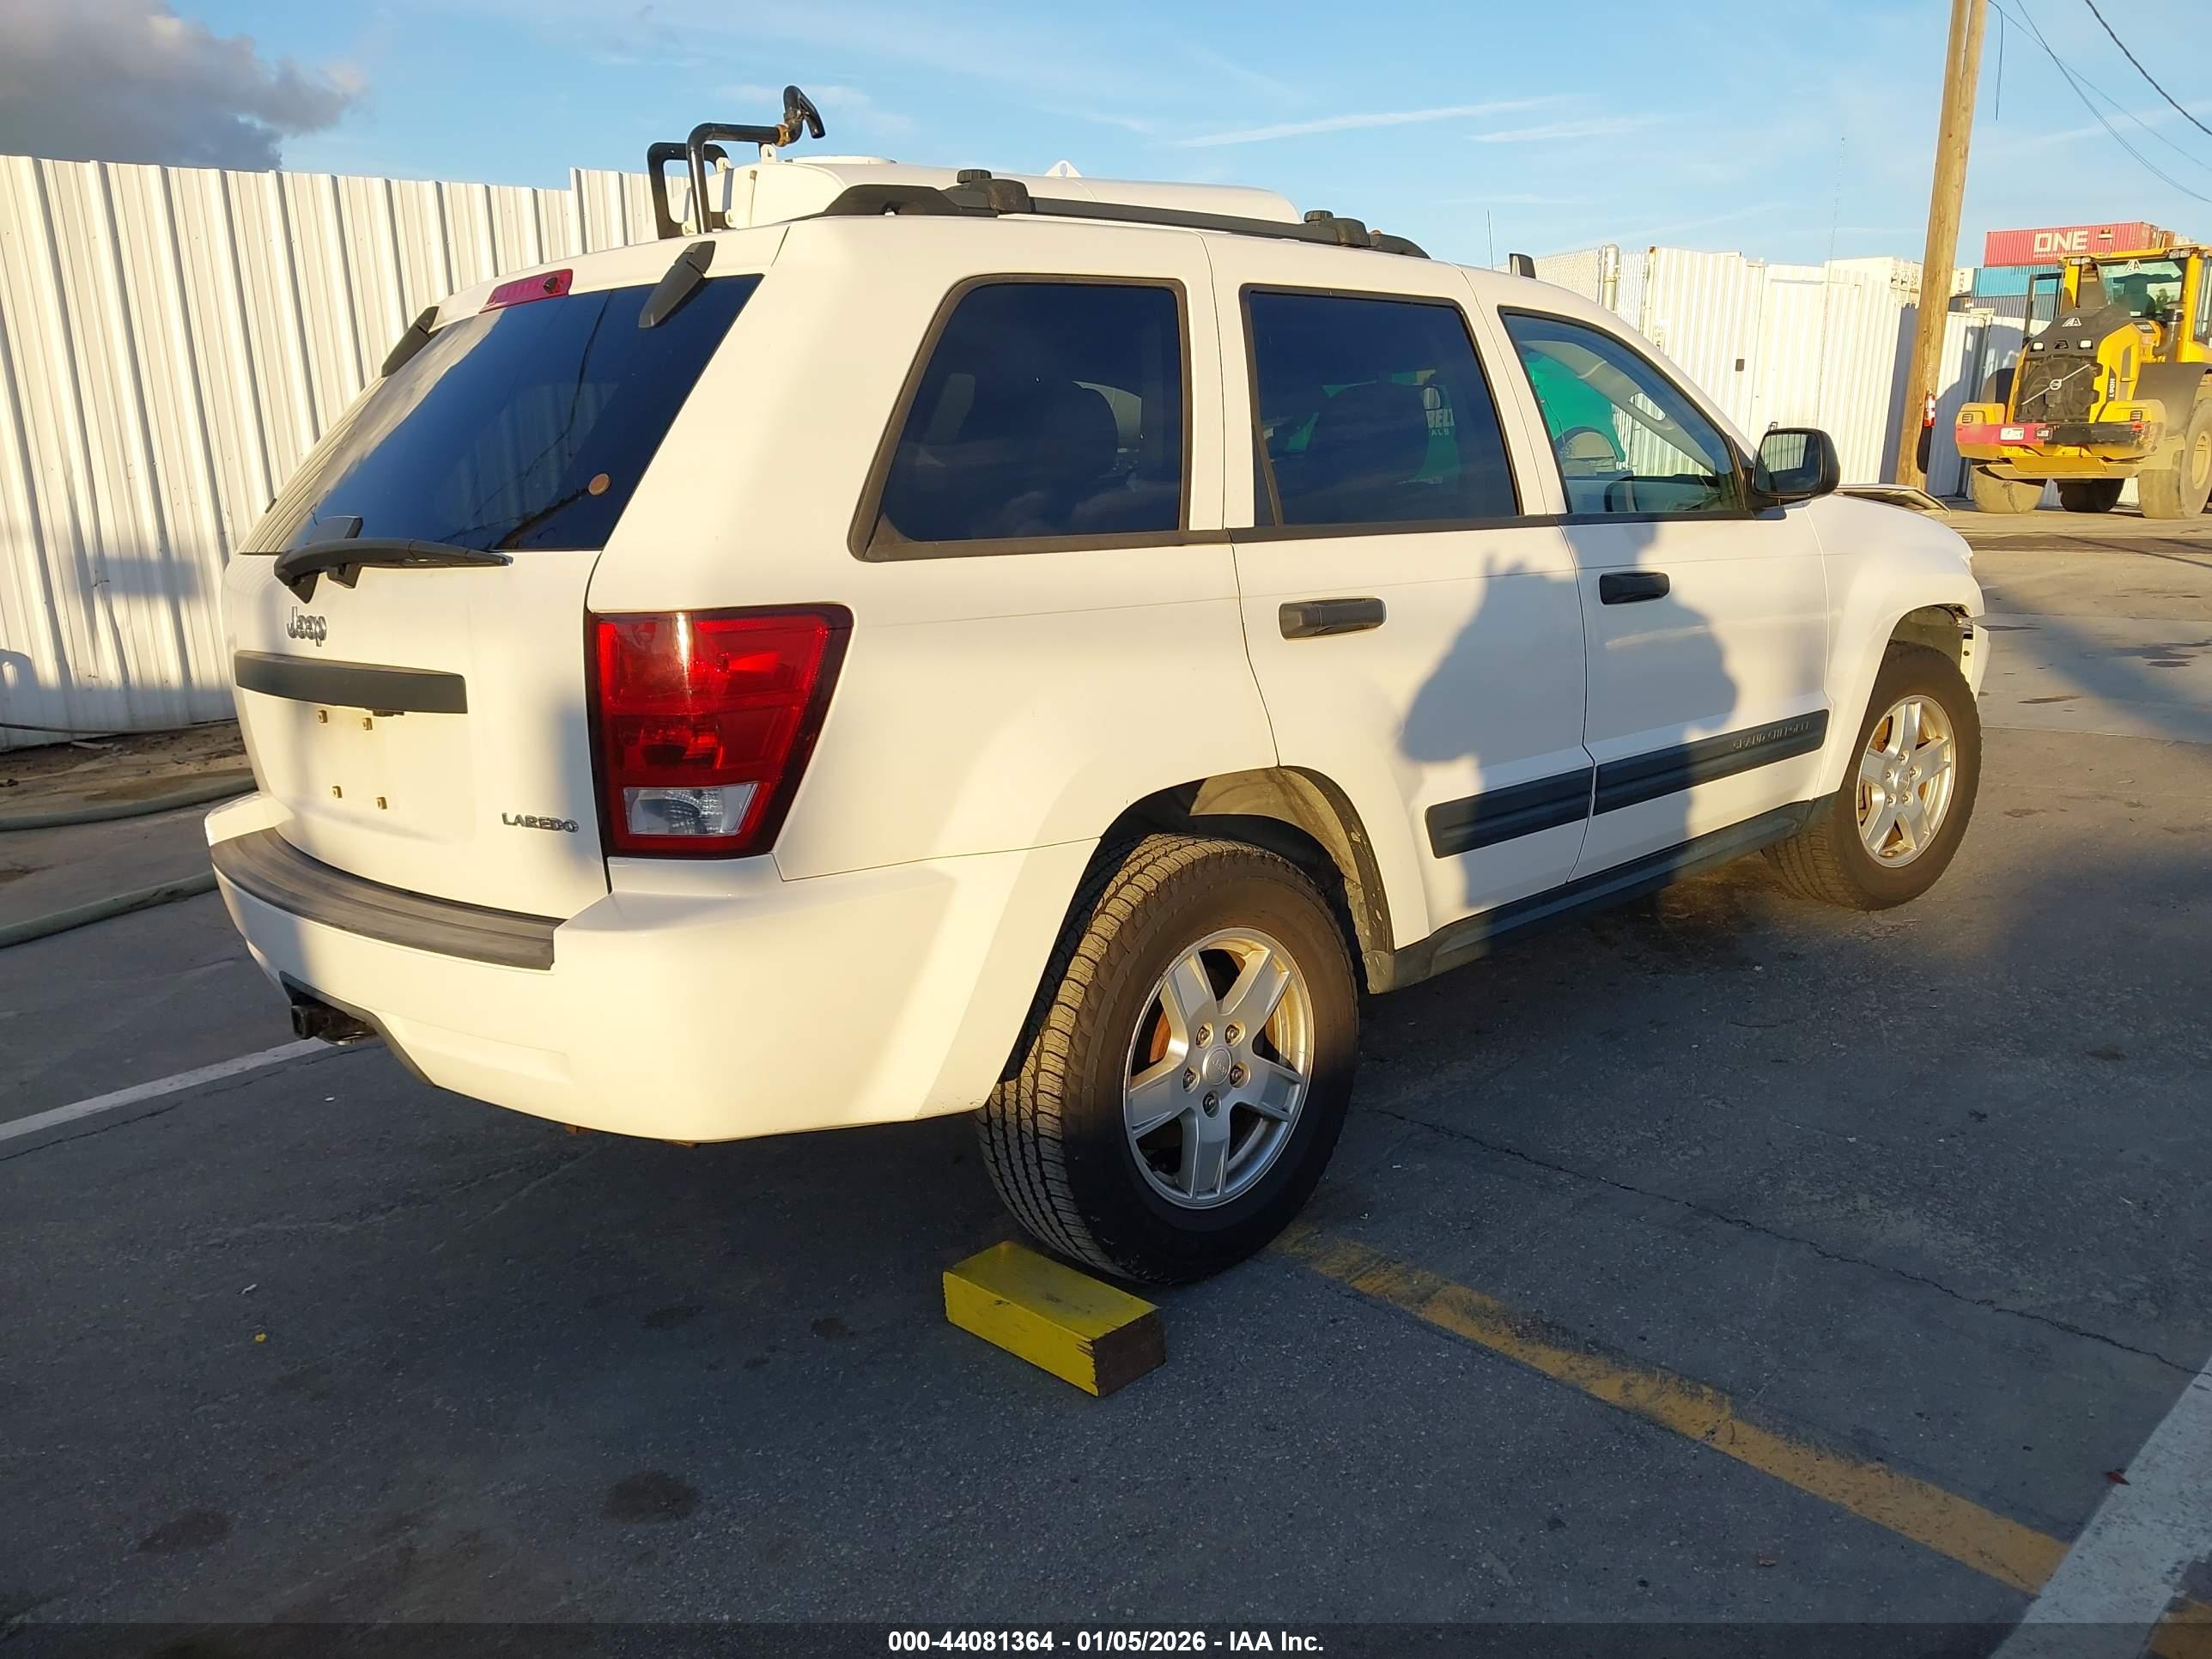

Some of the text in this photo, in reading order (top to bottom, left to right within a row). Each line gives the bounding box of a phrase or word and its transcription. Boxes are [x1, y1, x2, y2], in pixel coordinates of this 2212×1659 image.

[2033, 230, 2089, 252] ONE
[1429, 428, 1450, 436] ALS
[286, 605, 327, 647] Jeep
[501, 811, 580, 833] LAREDO
